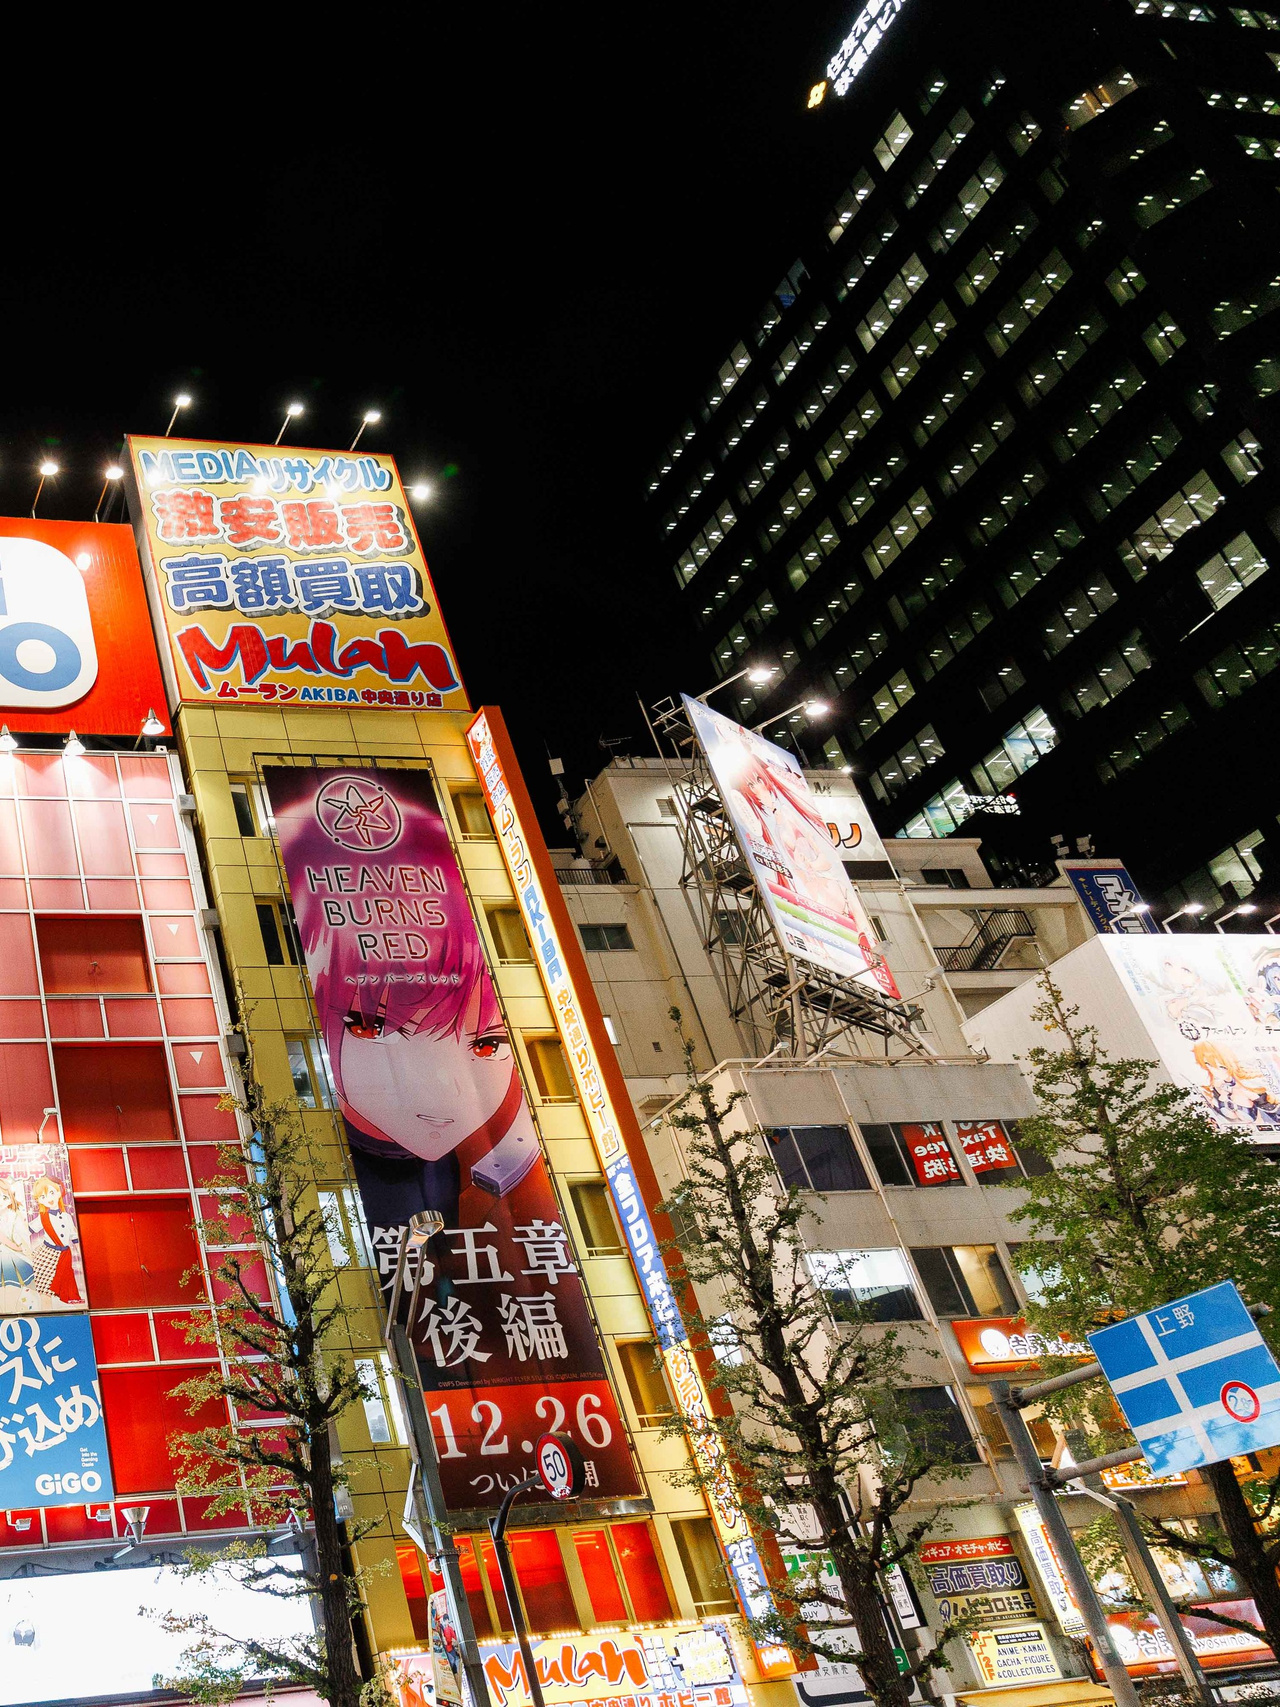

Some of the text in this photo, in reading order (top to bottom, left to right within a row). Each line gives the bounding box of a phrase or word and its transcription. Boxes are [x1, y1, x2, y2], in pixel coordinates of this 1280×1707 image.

[157, 491, 408, 552] 激安販売
[167, 556, 423, 612] 高額買取
[176, 621, 459, 691] Mulan
[306, 866, 446, 893] HEAVEN
[323, 899, 446, 926] BURNS
[358, 932, 429, 961] RED
[418, 1290, 569, 1368] 後編
[1155, 1303, 1195, 1337] 上野
[542, 1450, 566, 1482] 50
[35, 1470, 102, 1496] GiGO
[930, 1560, 1023, 1594] 高価買取り
[803, 1611, 818, 1620] BUY
